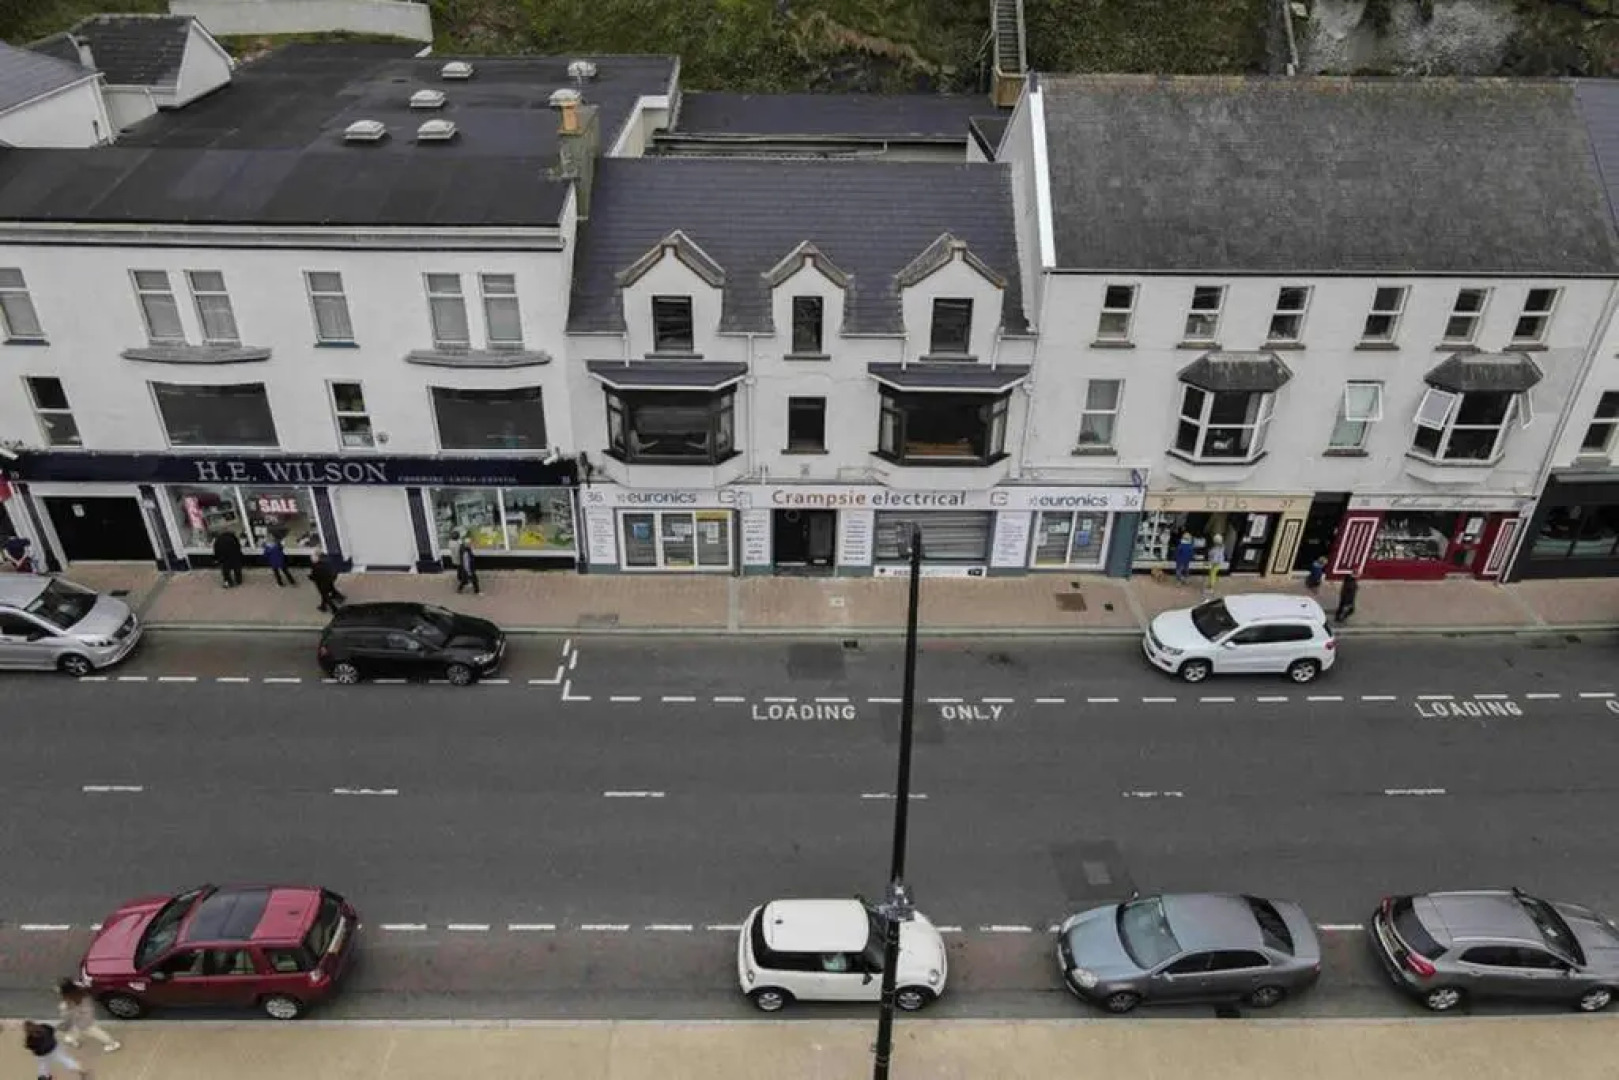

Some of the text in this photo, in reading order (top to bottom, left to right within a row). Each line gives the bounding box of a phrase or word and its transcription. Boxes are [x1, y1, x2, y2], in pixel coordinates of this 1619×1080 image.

[264, 462, 388, 483] WILSON
[586, 491, 603, 503] 36
[626, 491, 697, 504] euronics
[772, 489, 867, 507] Crampsie
[872, 489, 967, 506] electrical
[1039, 494, 1109, 507] euronics
[1123, 494, 1138, 507] 36
[258, 498, 298, 514] SALE
[752, 704, 1003, 720] LOADING ONLY
[1414, 701, 1524, 718] LOADING
